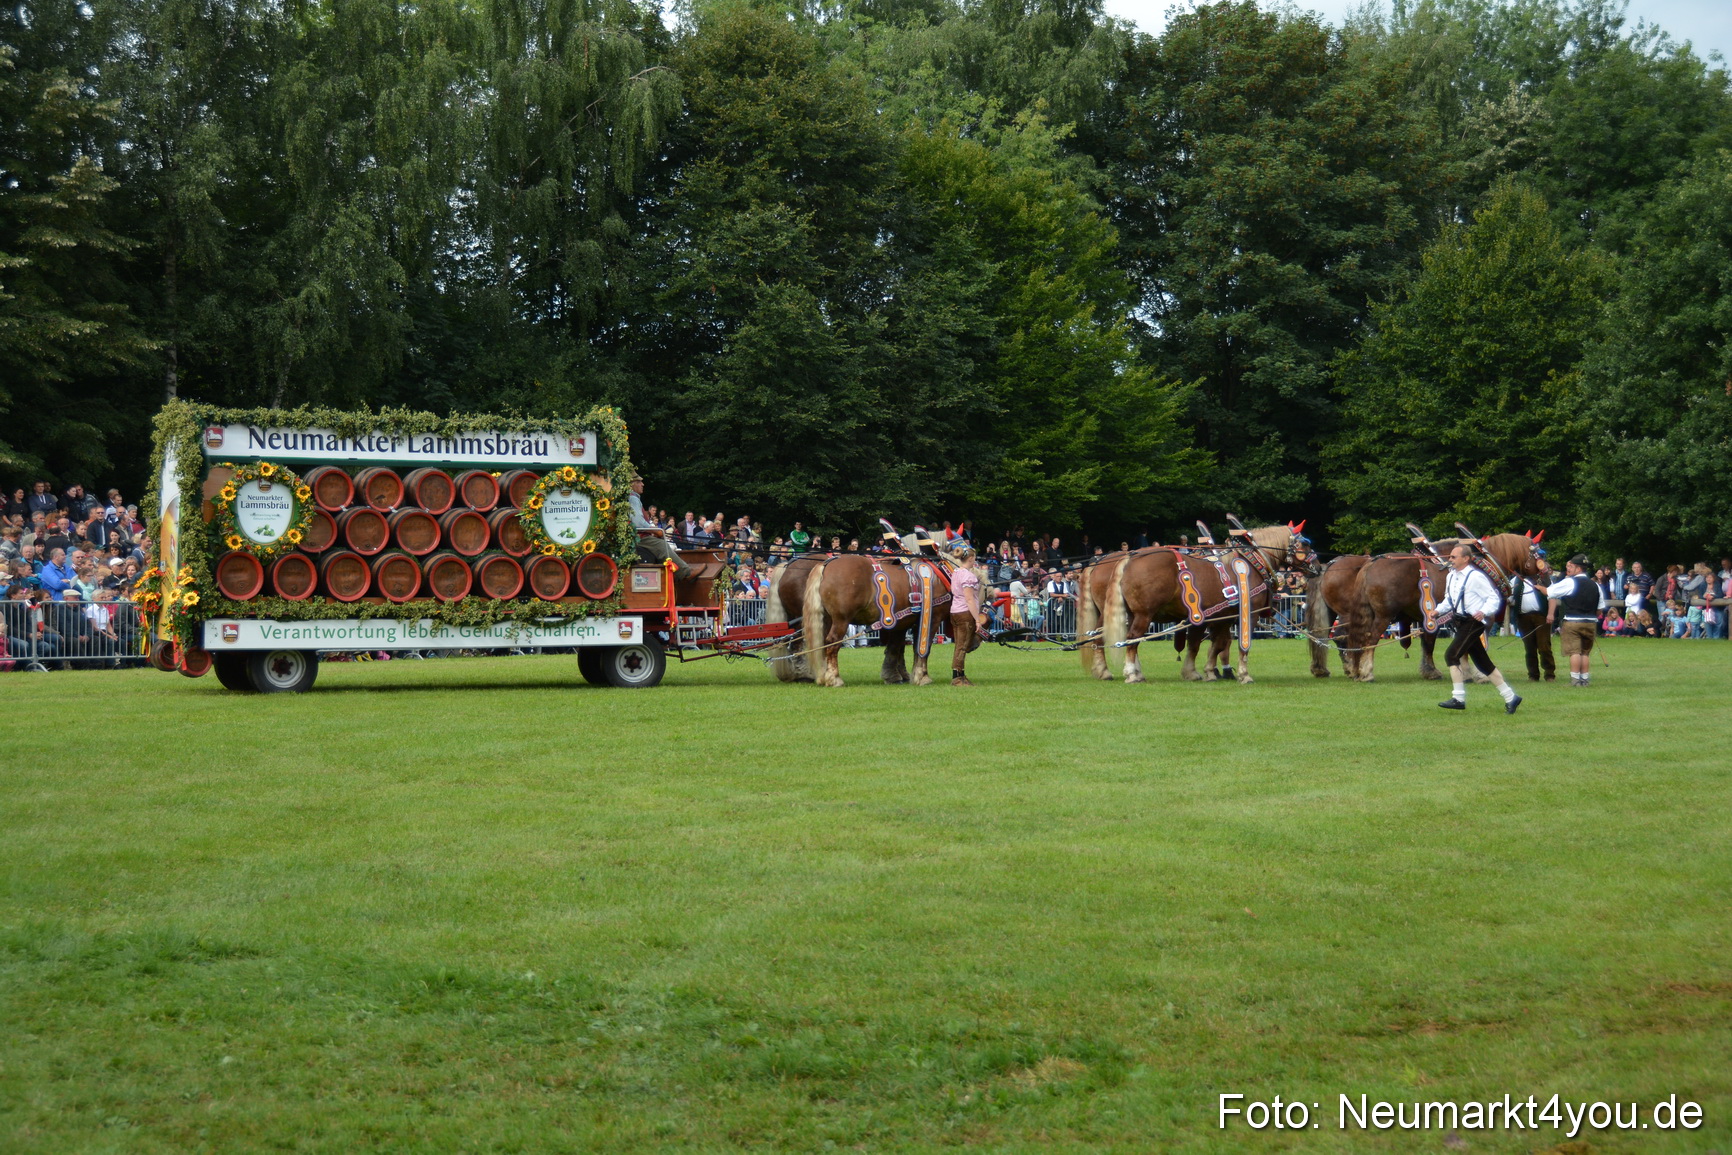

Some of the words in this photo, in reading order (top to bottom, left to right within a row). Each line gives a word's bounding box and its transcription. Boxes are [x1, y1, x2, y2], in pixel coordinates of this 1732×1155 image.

[248, 427, 397, 453] Neumarkter
[408, 433, 549, 457] Lammsbräu
[240, 501, 290, 510] Lammsbräu
[544, 505, 588, 514] Lammsbräu
[259, 624, 397, 643] Verantwortung
[402, 623, 455, 639] leben.
[525, 622, 601, 638] schaffen.
